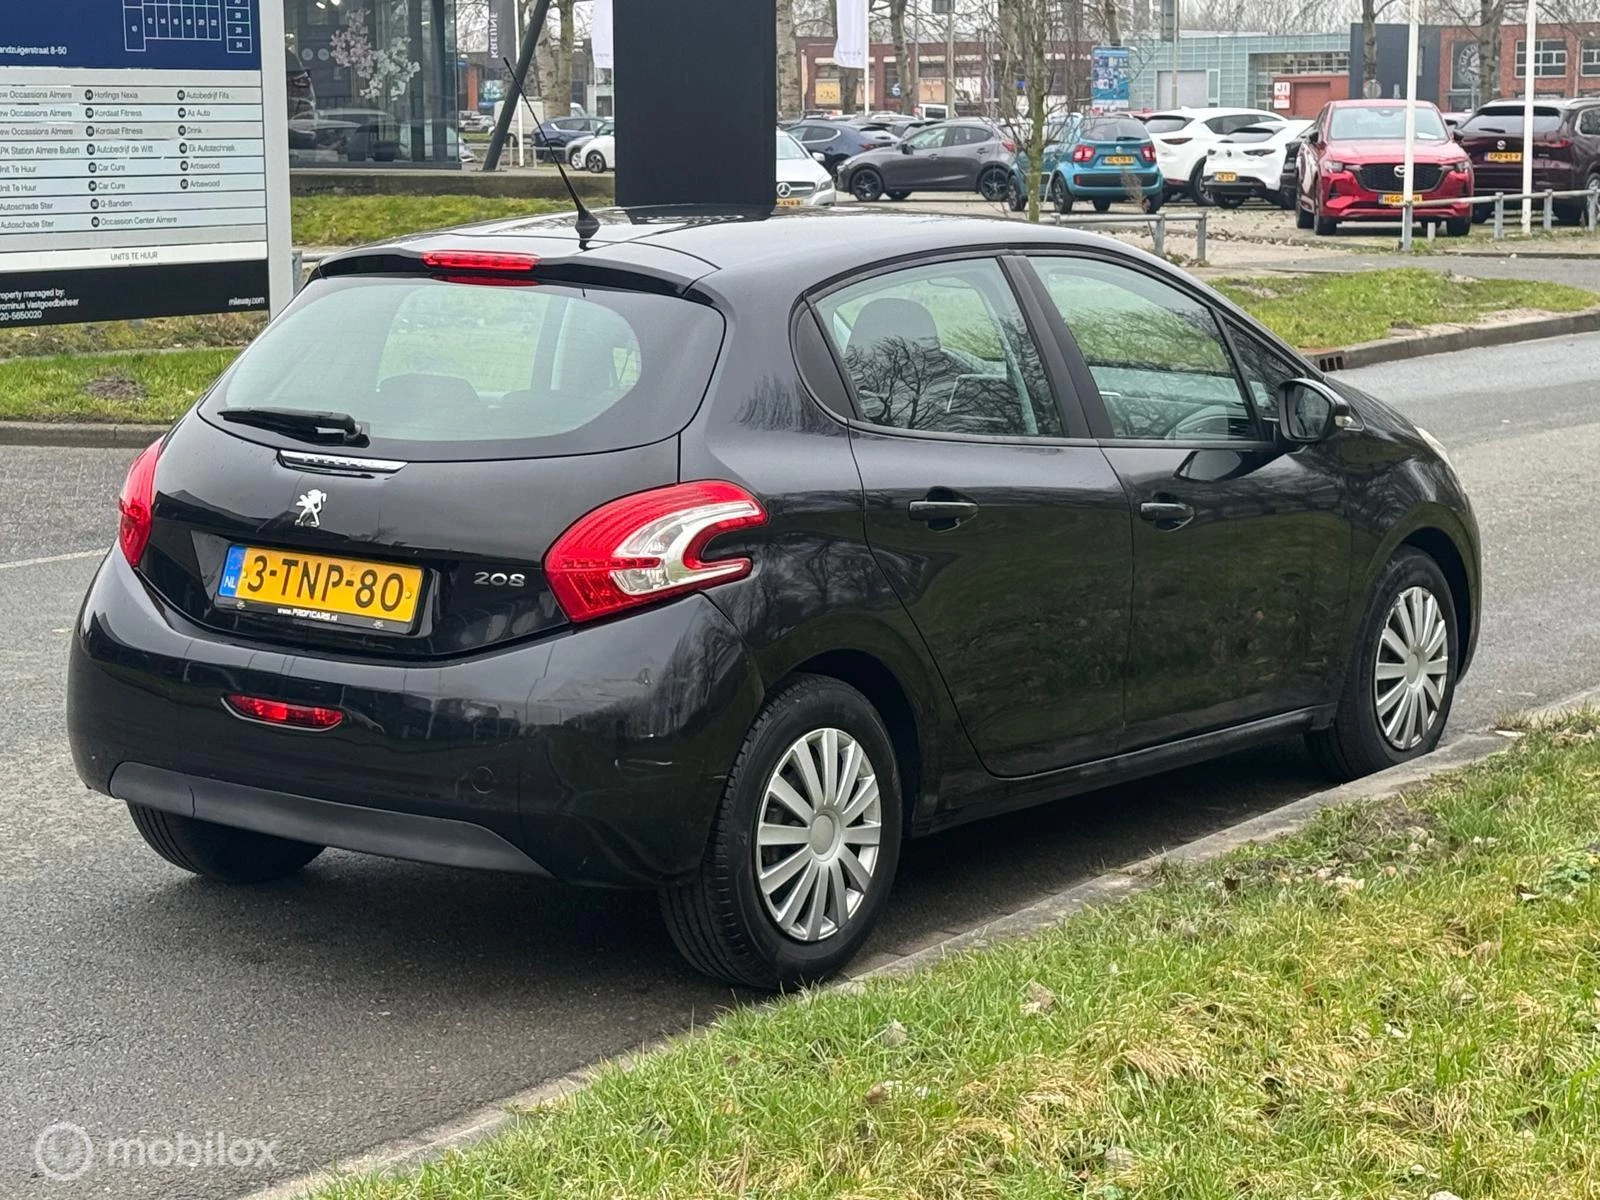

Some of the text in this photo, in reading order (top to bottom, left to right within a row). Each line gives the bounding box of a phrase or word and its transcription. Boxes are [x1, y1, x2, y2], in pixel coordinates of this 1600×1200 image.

[50, 46, 67, 55] 8-50
[49, 90, 72, 98] Almere
[50, 109, 72, 117] Almere
[121, 109, 142, 117] Fitness
[121, 127, 143, 135] Fitness
[0, 145, 80, 155] PK Station Almere Buiten
[11, 165, 20, 173] Te
[12, 184, 20, 192] Te
[98, 182, 109, 190] Car
[0, 203, 39, 211] Autoschade
[100, 200, 133, 208] Q-Banden
[134, 216, 155, 224] Center
[1, 220, 55, 229] Autoschade Ster
[111, 251, 158, 260] UNITS TE HUUR
[23, 288, 54, 299] managed
[55, 288, 66, 298] by:
[26, 299, 79, 310] Vastgoedbeheer
[229, 297, 265, 306] mileway.com
[223, 575, 236, 588] NL
[473, 571, 525, 587] 208
[247, 555, 404, 612] 3-TNP-80
